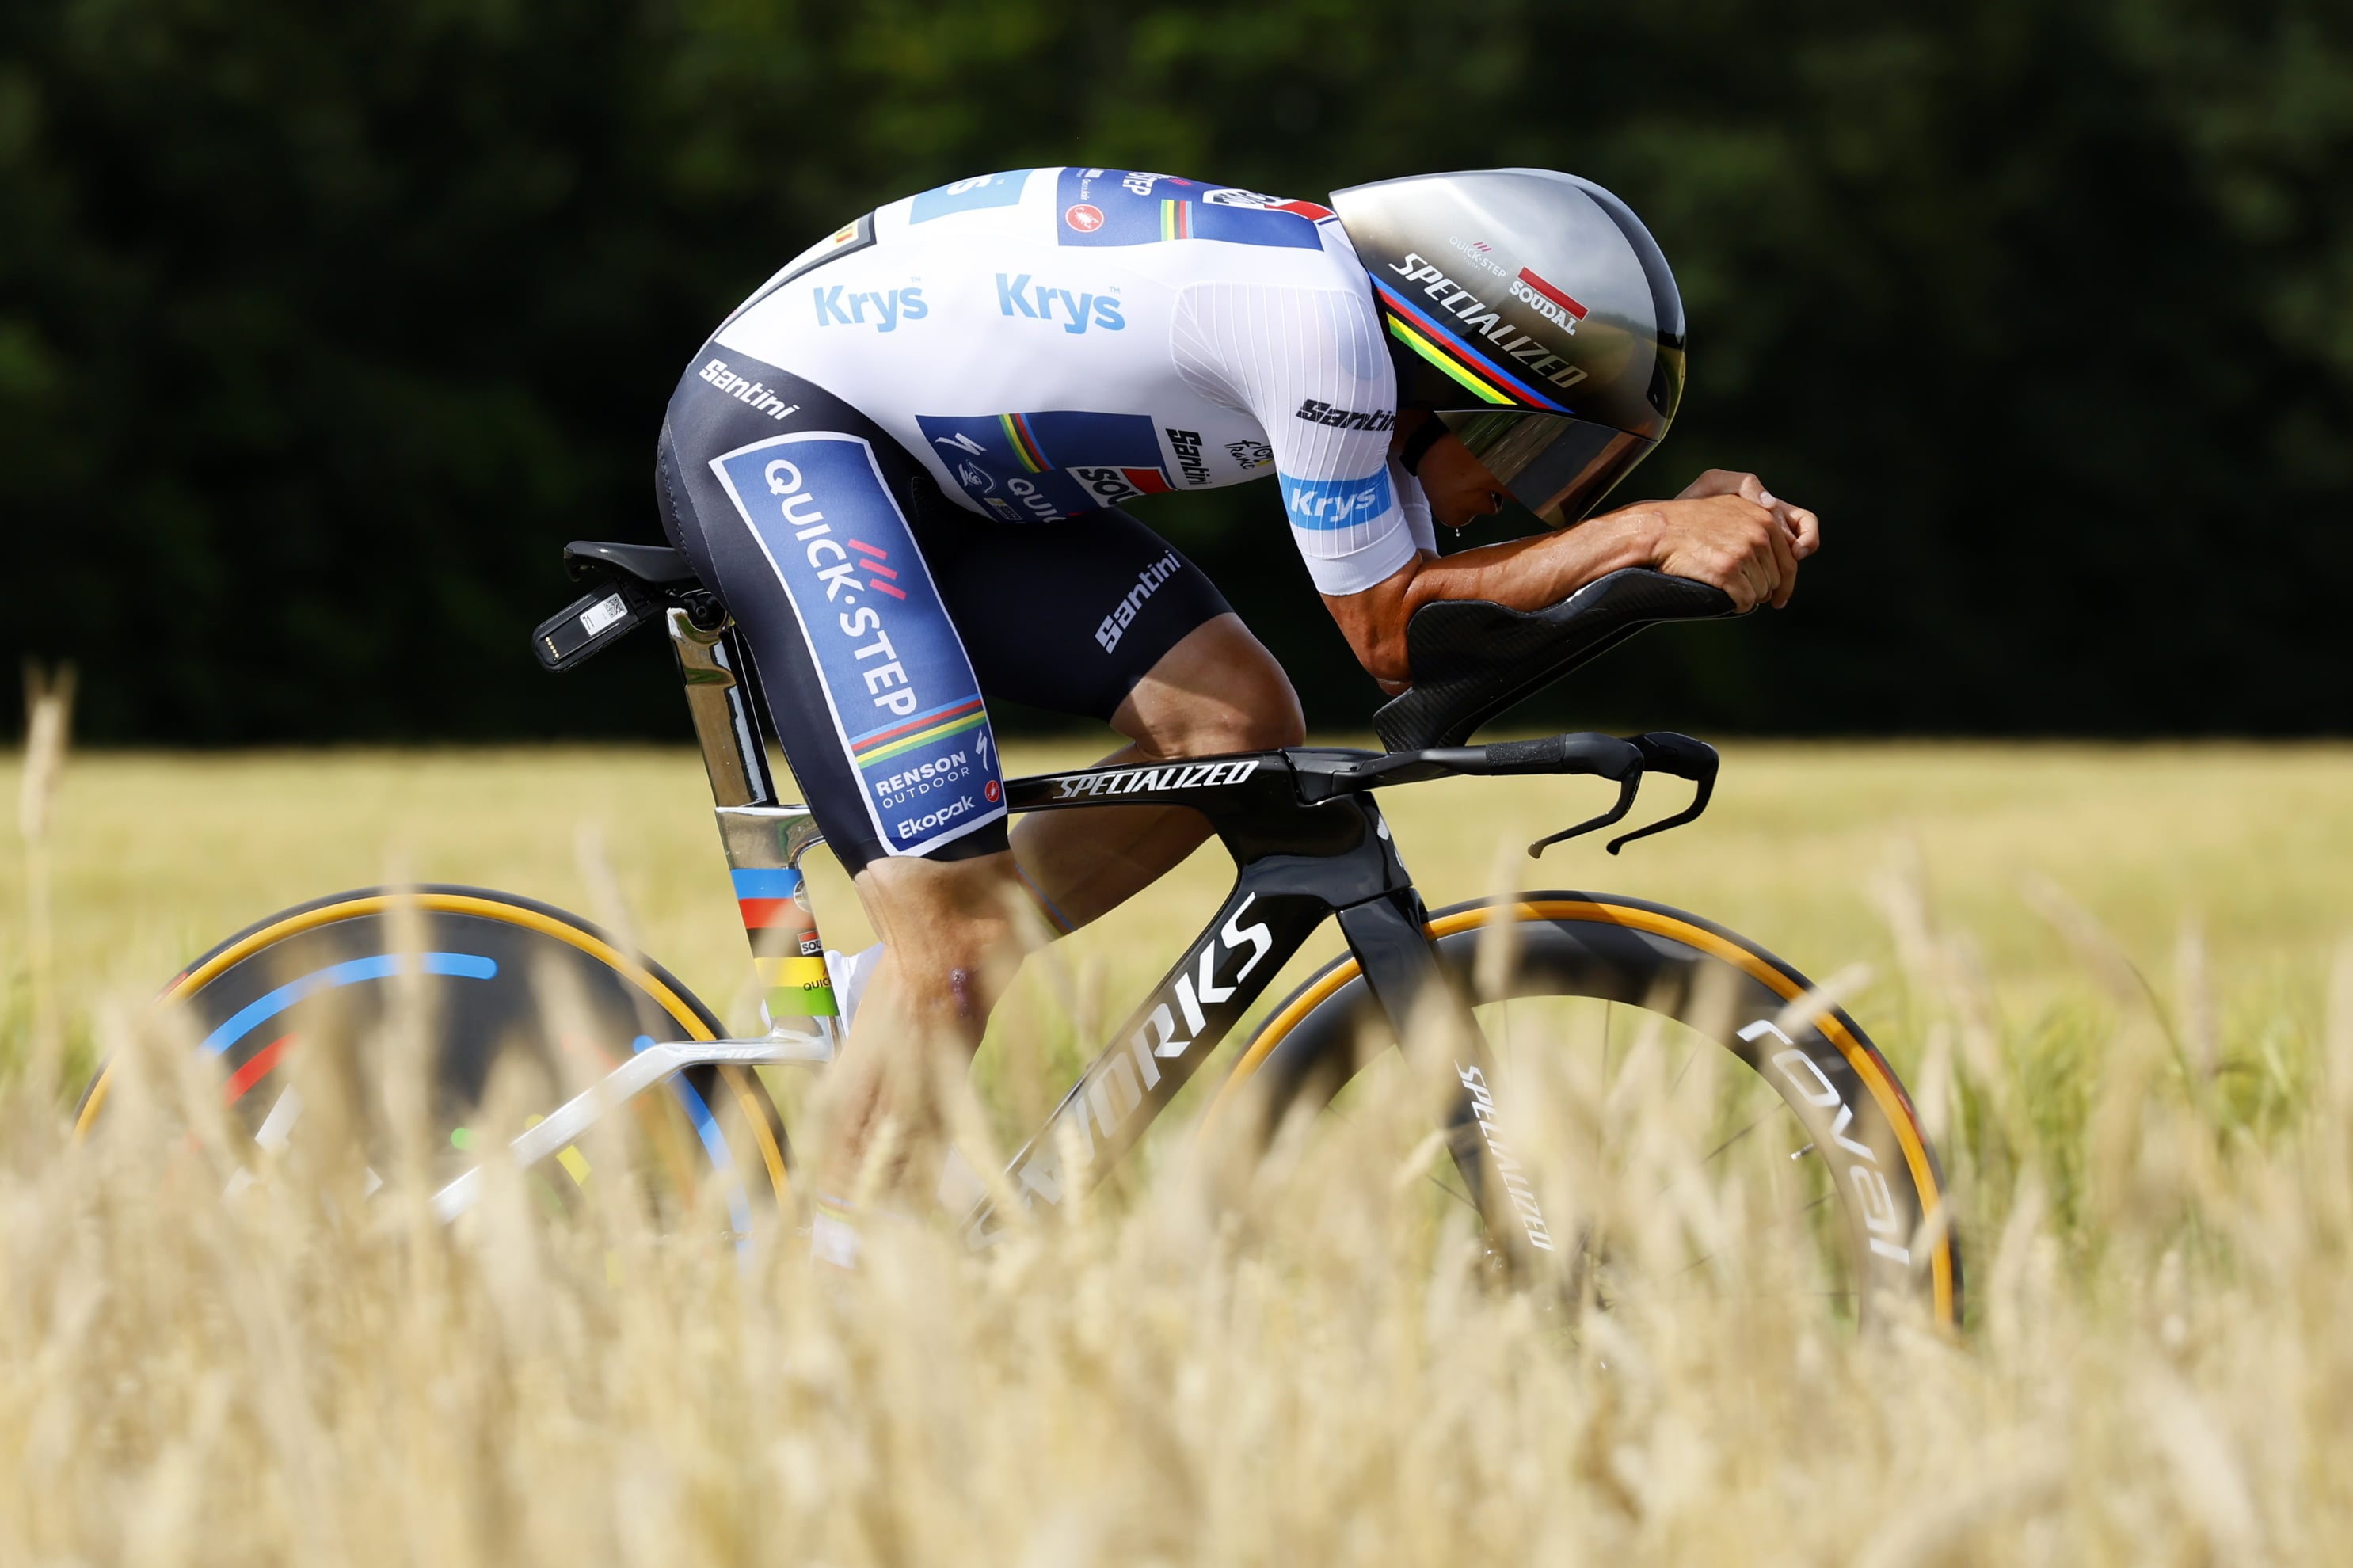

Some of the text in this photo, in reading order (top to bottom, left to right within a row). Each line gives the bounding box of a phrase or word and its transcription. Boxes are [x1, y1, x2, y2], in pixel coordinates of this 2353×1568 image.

[813, 284, 929, 333] Krys
[995, 272, 1125, 335] Krys
[1388, 253, 1588, 389] SPECIALIZED
[1508, 280, 1577, 337] SOUDAL
[699, 358, 800, 421] Santini
[1165, 428, 1213, 485] Santini
[1290, 487, 1376, 523] Krys
[1094, 549, 1182, 655] Santini
[875, 750, 967, 797] RENSON
[882, 767, 970, 809] OUTDOOR
[1053, 759, 1261, 800] SPECIALIZED
[897, 794, 976, 840] Ekopak
